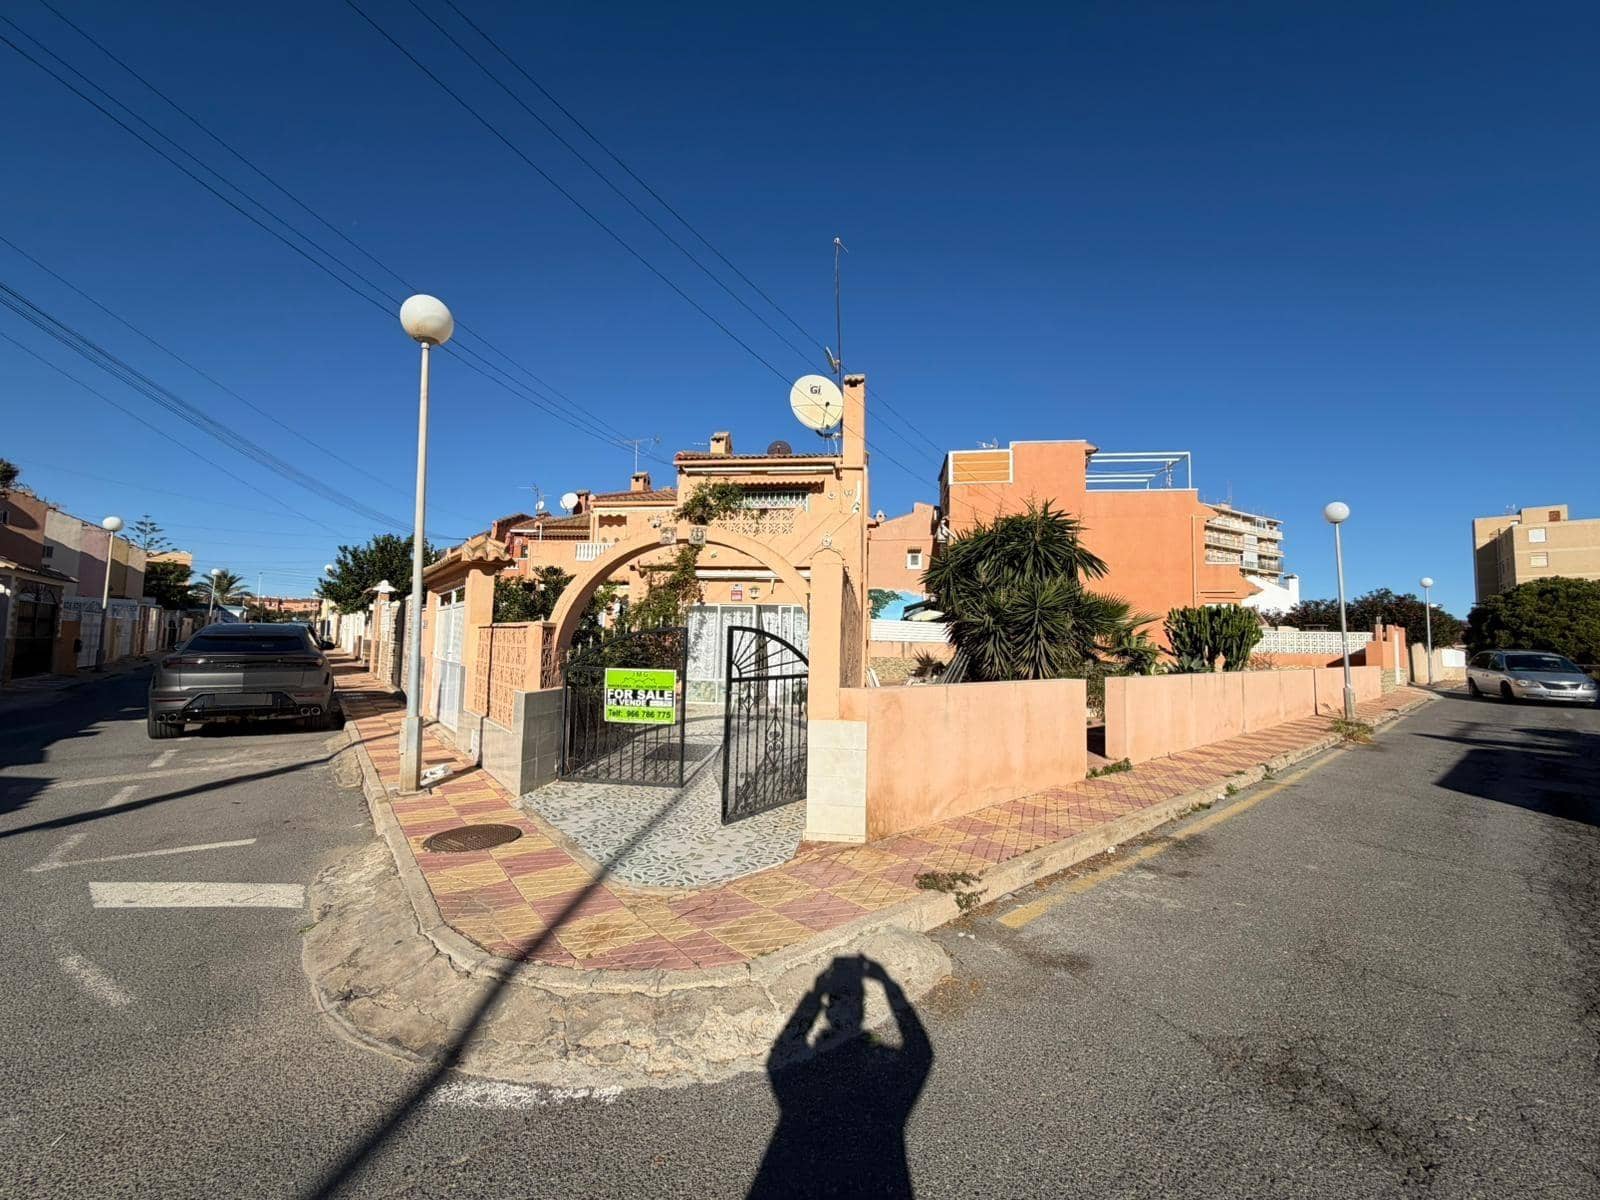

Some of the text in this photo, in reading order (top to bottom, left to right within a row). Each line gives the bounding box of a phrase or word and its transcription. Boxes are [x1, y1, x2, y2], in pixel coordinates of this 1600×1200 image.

[607, 688, 673, 700] FOR SALE
[607, 698, 617, 706] SE
[619, 699, 647, 707] VENDE
[657, 711, 671, 719] 775
